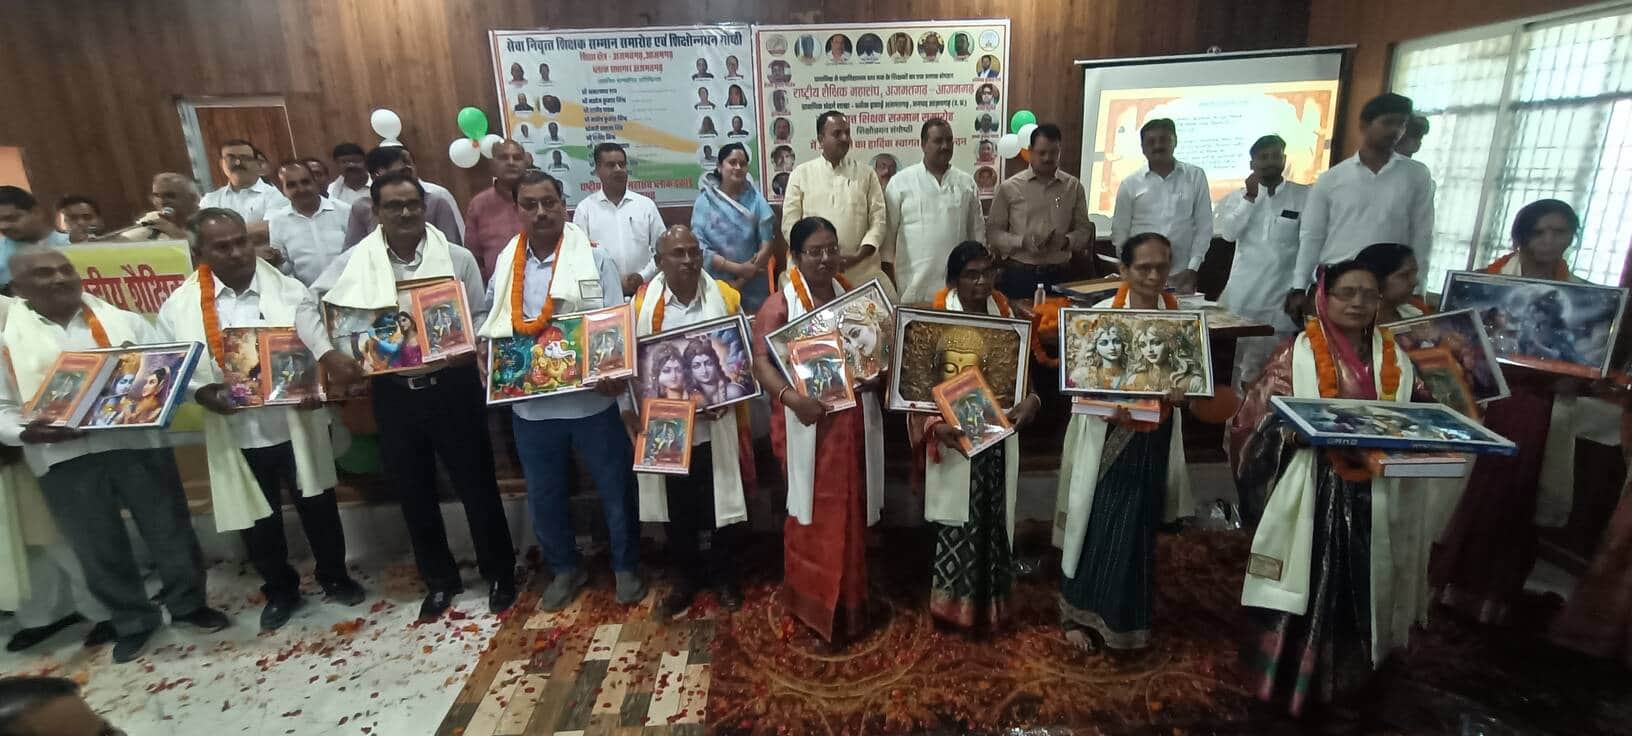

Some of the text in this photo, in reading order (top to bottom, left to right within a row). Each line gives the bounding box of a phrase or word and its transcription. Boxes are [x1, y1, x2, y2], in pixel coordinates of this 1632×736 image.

[507, 38, 524, 52] सेवा
[526, 37, 554, 54] निवृत्त
[556, 37, 587, 51] शिक्षक
[589, 38, 618, 49] सम्मान
[620, 34, 652, 48] समारोह
[655, 33, 667, 47] एवं
[720, 31, 742, 46] गोष्ठी
[794, 84, 819, 99] राष्ट्रीय
[822, 83, 848, 97] शैक्षिक
[859, 112, 886, 123] शिक्षक
[889, 112, 919, 122] सम्मान
